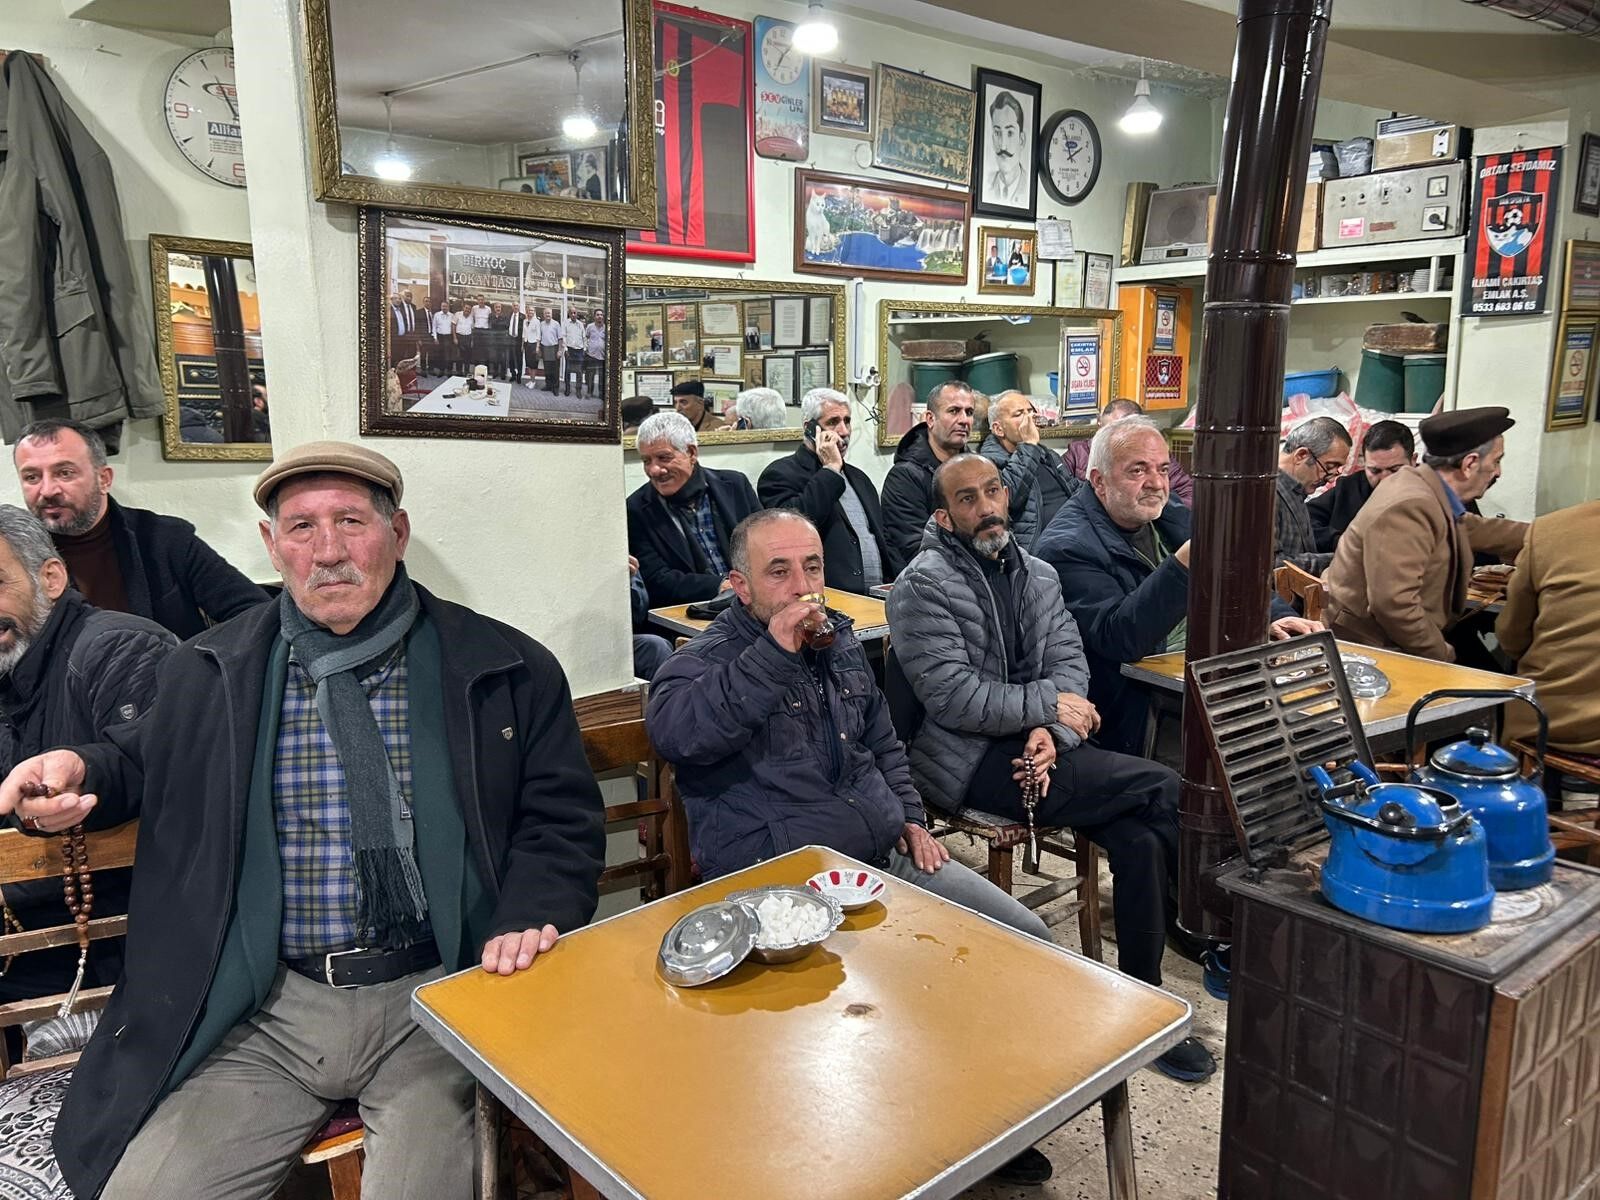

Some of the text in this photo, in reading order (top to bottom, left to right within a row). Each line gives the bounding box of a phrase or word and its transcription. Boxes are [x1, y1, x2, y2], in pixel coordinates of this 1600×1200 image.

[174, 102, 189, 118] 9
[210, 123, 241, 137] Allia
[1480, 160, 1557, 178] ORTAK SEVDAMIZ
[452, 272, 517, 289] LOKANTASI
[1482, 290, 1511, 300] EMLAK
[1472, 302, 1494, 312] 0533
